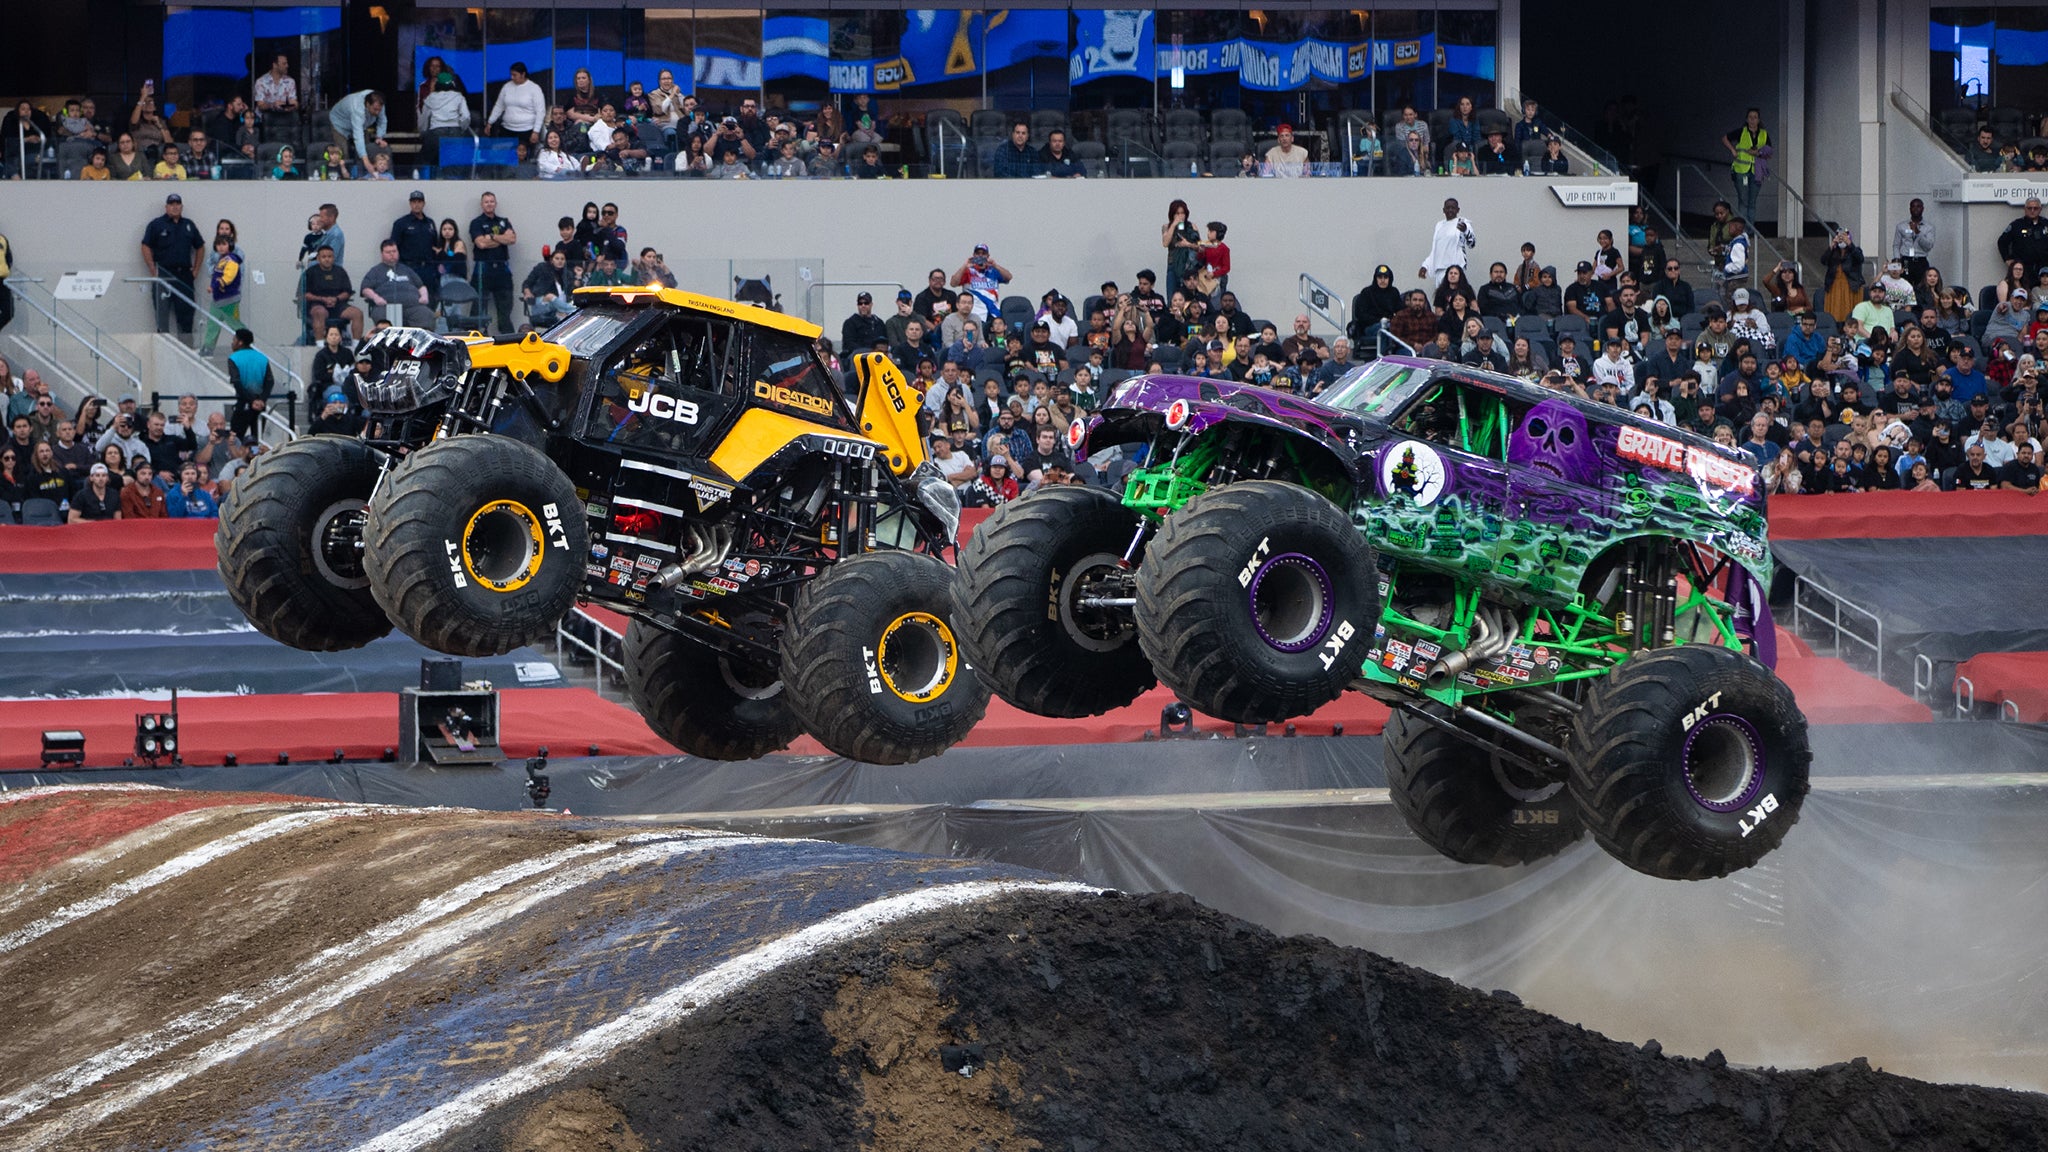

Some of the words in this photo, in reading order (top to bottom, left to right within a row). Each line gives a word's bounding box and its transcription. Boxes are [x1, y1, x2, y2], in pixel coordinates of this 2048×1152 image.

[1565, 192, 1579, 202] VIP
[1581, 192, 1607, 202] ENTRY
[1993, 188, 2008, 198] VIP
[2011, 188, 2039, 198] ENTRY
[688, 299, 709, 311] TRISTAN
[709, 304, 735, 315] ENGLAND
[389, 360, 421, 375] JCB
[628, 391, 699, 425] JCB
[754, 380, 834, 412] DIGATRON
[881, 371, 906, 413] JCB
[1617, 425, 1684, 472] GRAVE
[1686, 445, 1754, 494] DIGGER
[688, 481, 732, 499] MONSTER
[697, 491, 719, 502] JAM
[542, 502, 570, 551] BKT
[444, 539, 468, 589] BKT
[1237, 537, 1271, 589] BKT
[710, 577, 739, 590] ARP
[1047, 567, 1061, 622] BKT
[1318, 619, 1356, 672] BKT
[862, 646, 883, 694] BKT
[1398, 676, 1421, 690] UNOH
[1497, 665, 1529, 679] ARP
[1682, 690, 1723, 733] BKT
[1513, 809, 1560, 824] BKT
[1737, 793, 1780, 838] BKT
